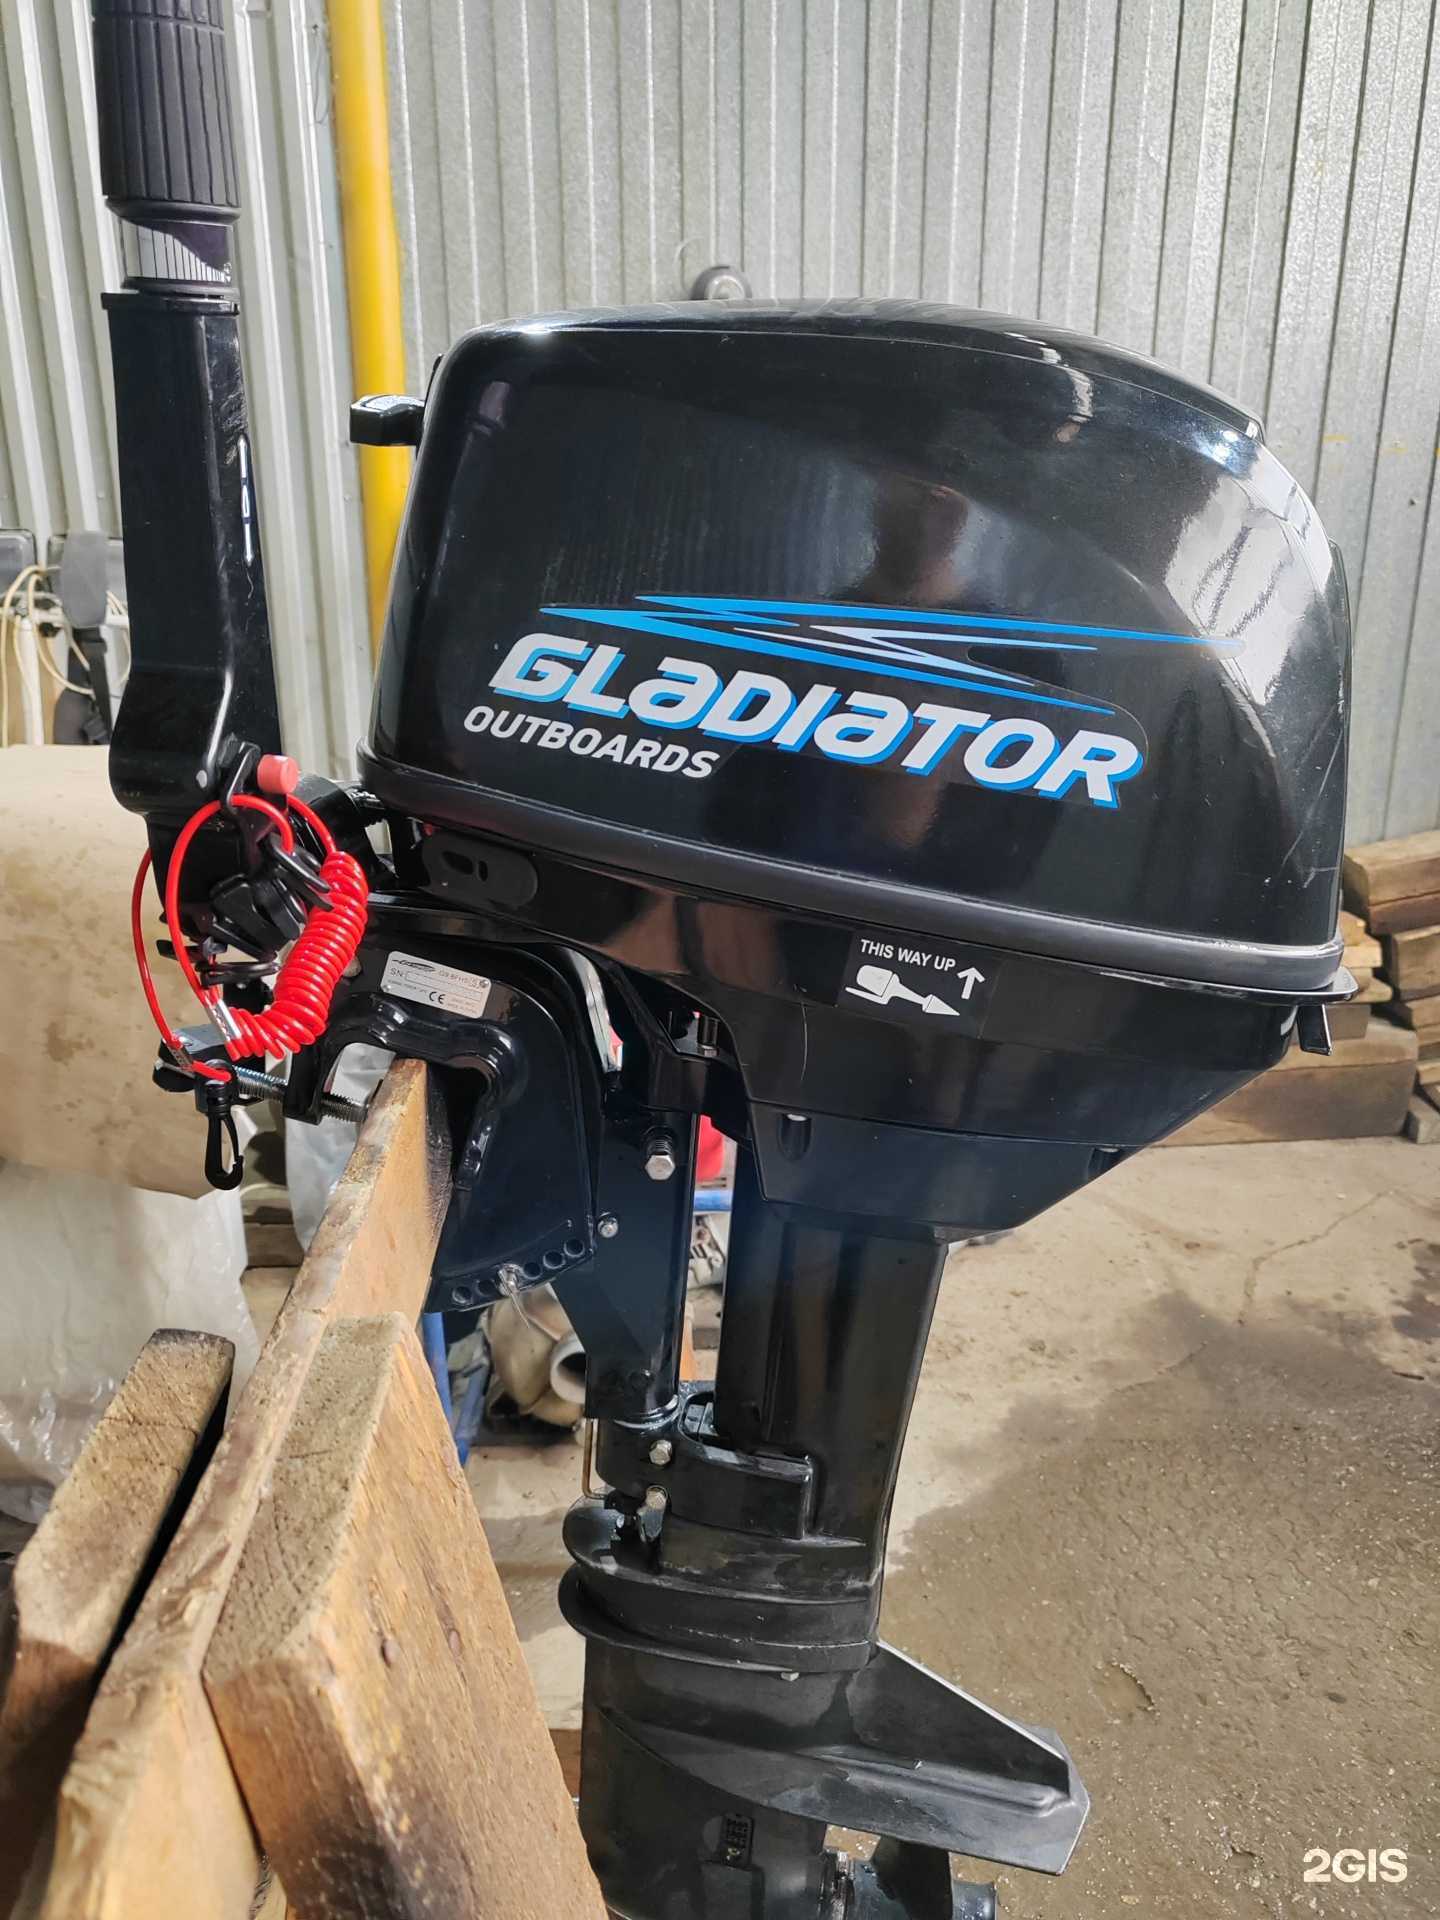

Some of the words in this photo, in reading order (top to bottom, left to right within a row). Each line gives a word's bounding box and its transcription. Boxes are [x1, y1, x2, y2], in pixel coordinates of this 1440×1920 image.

[464, 706, 720, 778] OUTBOARDS
[861, 939, 894, 959] THIS
[898, 947, 931, 967] WAY
[934, 957, 956, 972] UP
[429, 991, 446, 1004] CE
